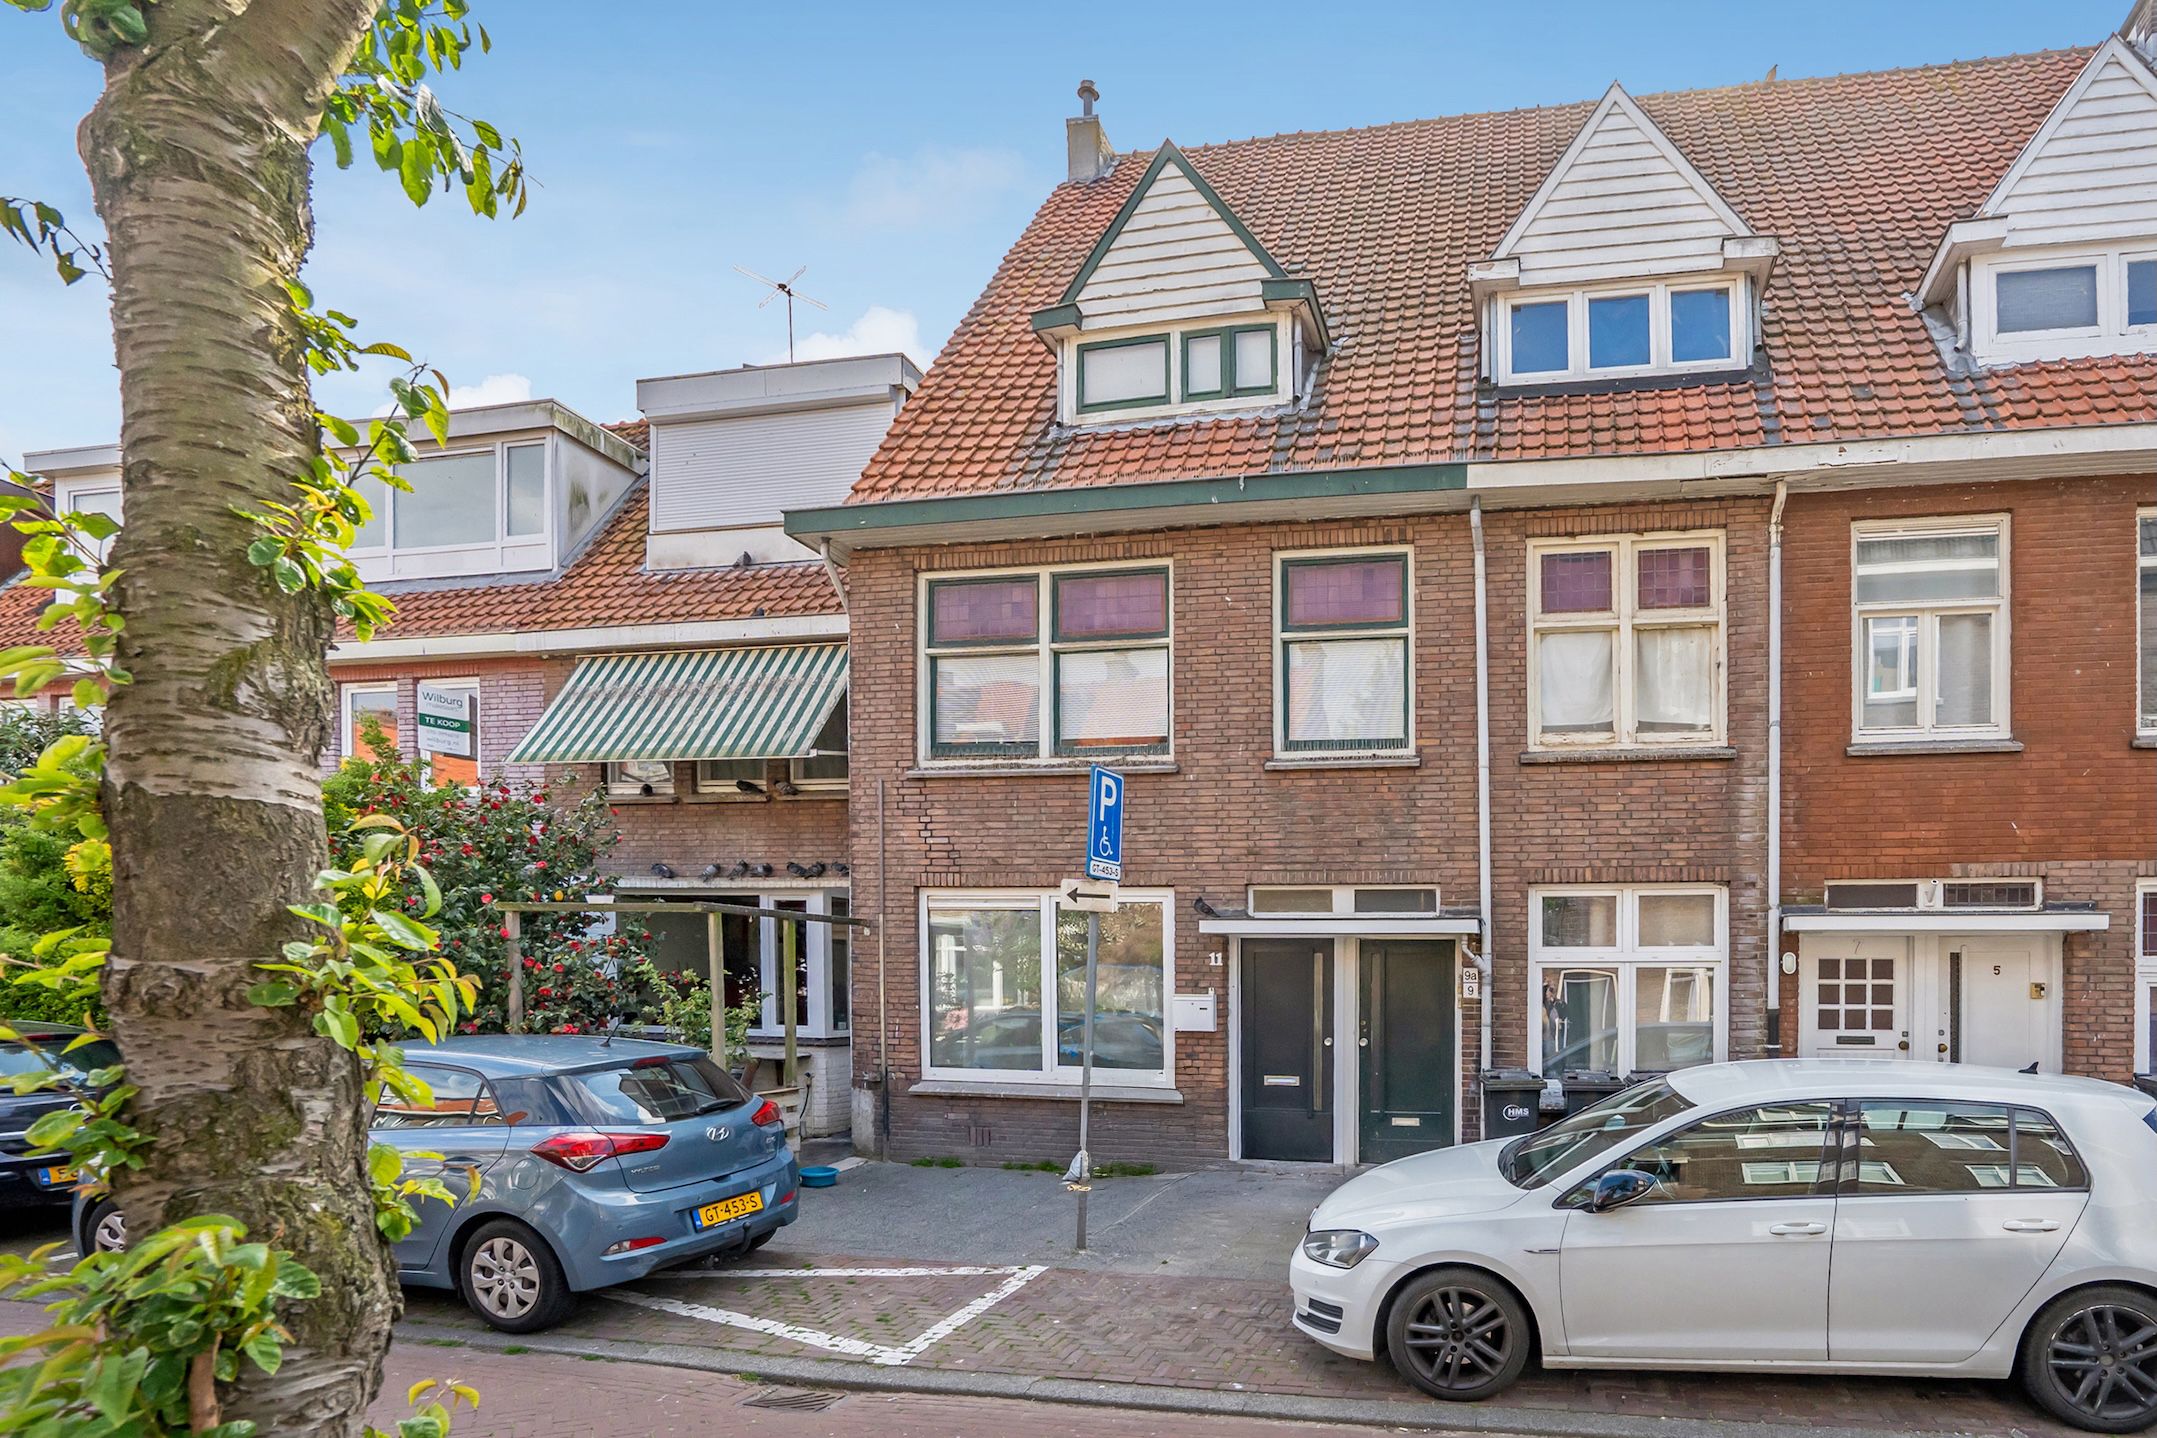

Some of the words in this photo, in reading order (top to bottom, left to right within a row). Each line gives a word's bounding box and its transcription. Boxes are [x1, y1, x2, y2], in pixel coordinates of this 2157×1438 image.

[422, 690, 463, 709] Wilburg
[425, 716, 436, 724] TE
[437, 719, 461, 728] KOOP
[1099, 775, 1117, 821] P
[1092, 863, 1119, 877] GT-453-S
[1208, 951, 1223, 966] 11
[1464, 970, 1477, 981] 9a
[1993, 965, 2001, 976] 5
[1467, 985, 1474, 996] 9
[1507, 1107, 1530, 1116] HMS
[705, 1195, 758, 1222] GT-453-S
